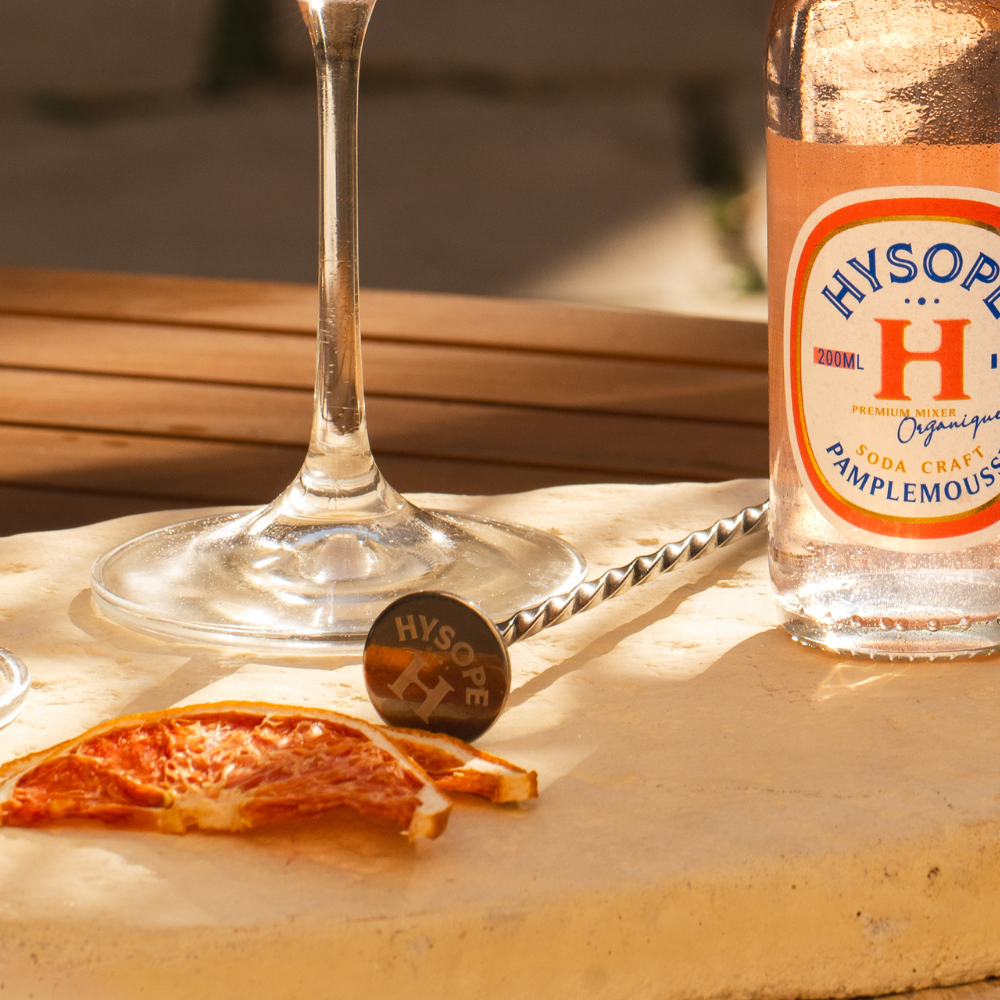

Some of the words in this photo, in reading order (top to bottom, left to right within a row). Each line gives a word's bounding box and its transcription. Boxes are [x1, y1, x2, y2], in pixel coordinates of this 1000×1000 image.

[818, 348, 864, 370] 200ML
[873, 317, 972, 401] H
[852, 404, 910, 418] PREMIUM
[915, 407, 957, 418] MIXER
[855, 444, 907, 473] SODA
[921, 445, 985, 474] CRAFT
[394, 614, 489, 707] HYSOPE
[387, 650, 455, 725] H
